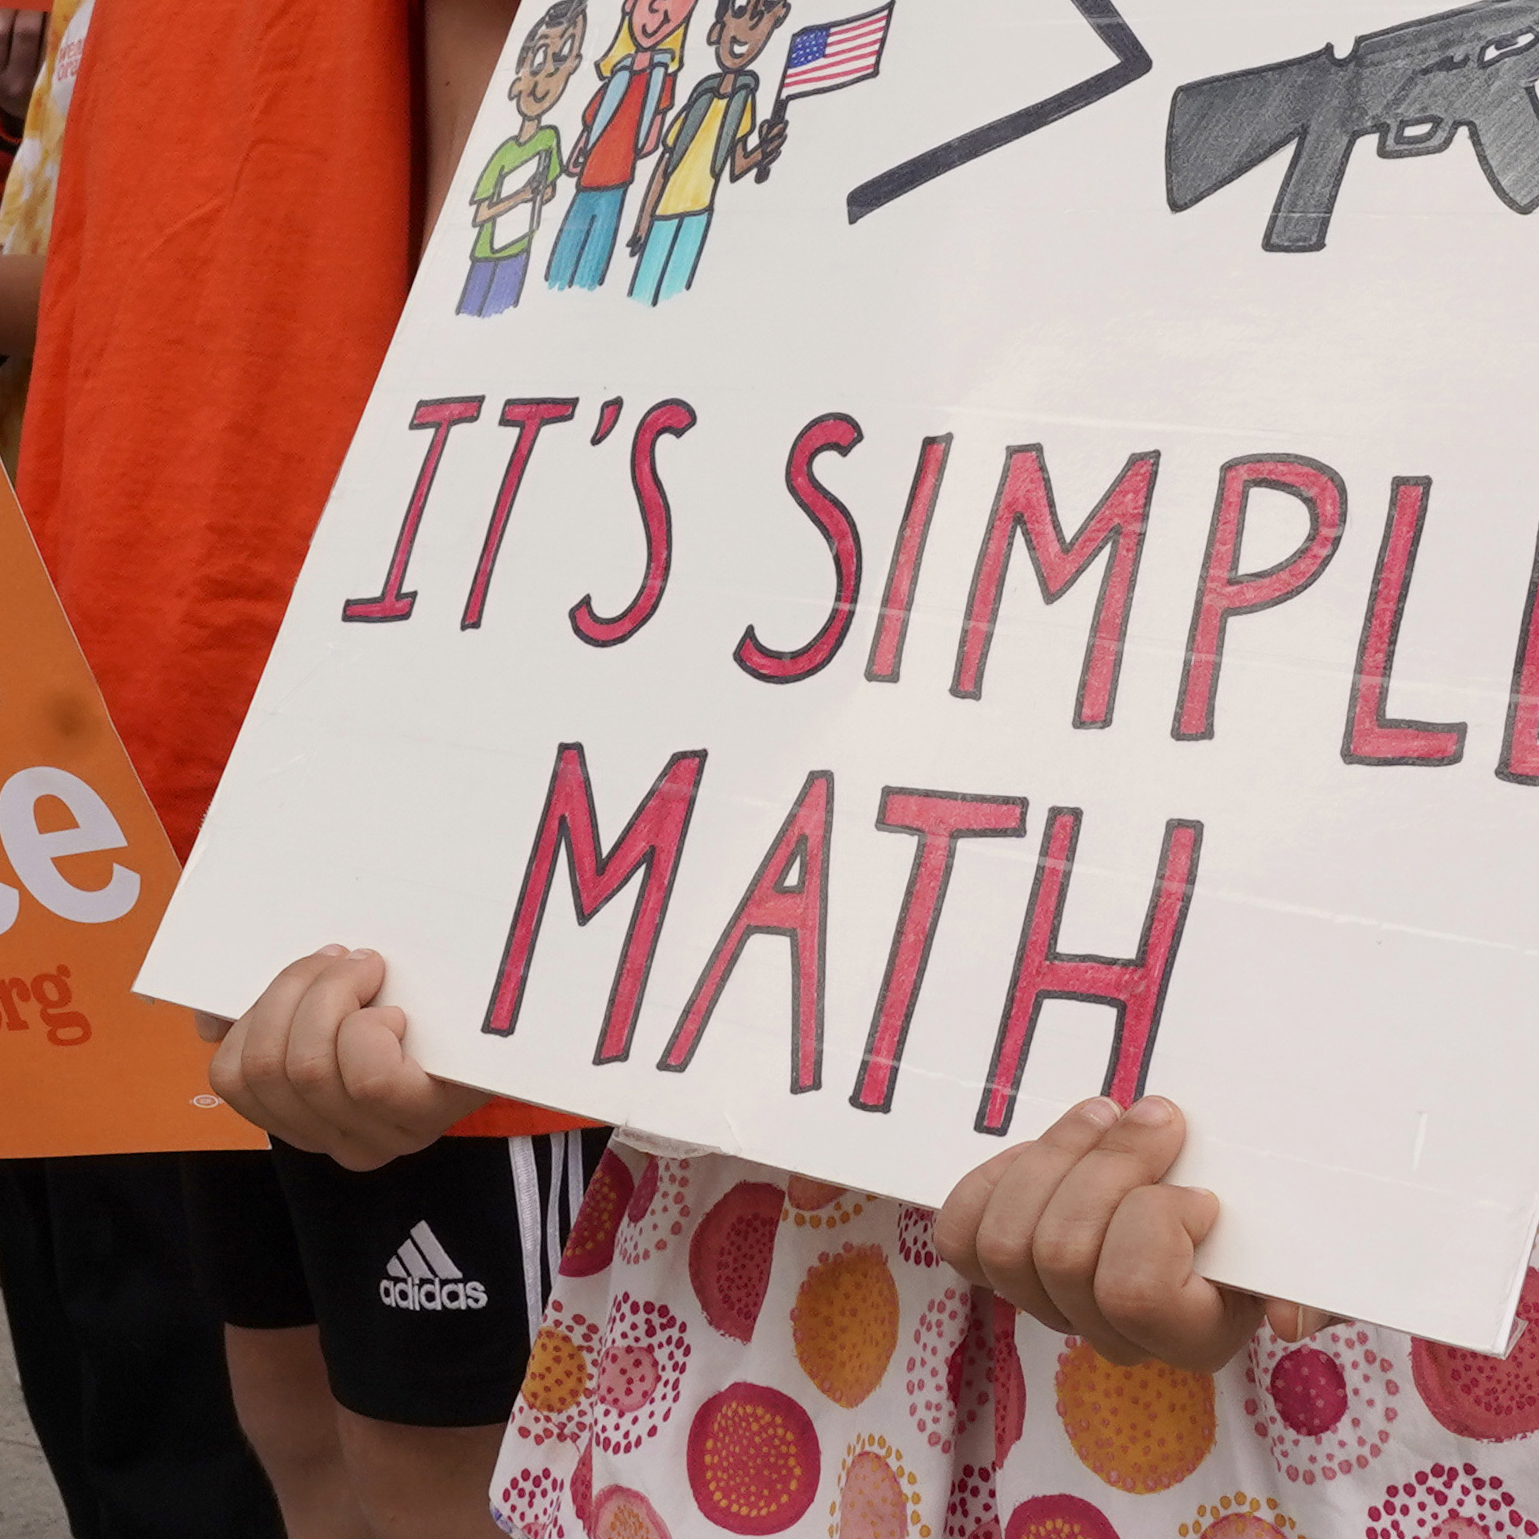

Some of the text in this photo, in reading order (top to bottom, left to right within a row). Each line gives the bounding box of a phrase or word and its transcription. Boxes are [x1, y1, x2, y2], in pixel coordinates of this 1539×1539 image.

[341, 394, 698, 649] IT'S
[480, 741, 1205, 1136] MATH
[379, 1276, 489, 1311] adidas
